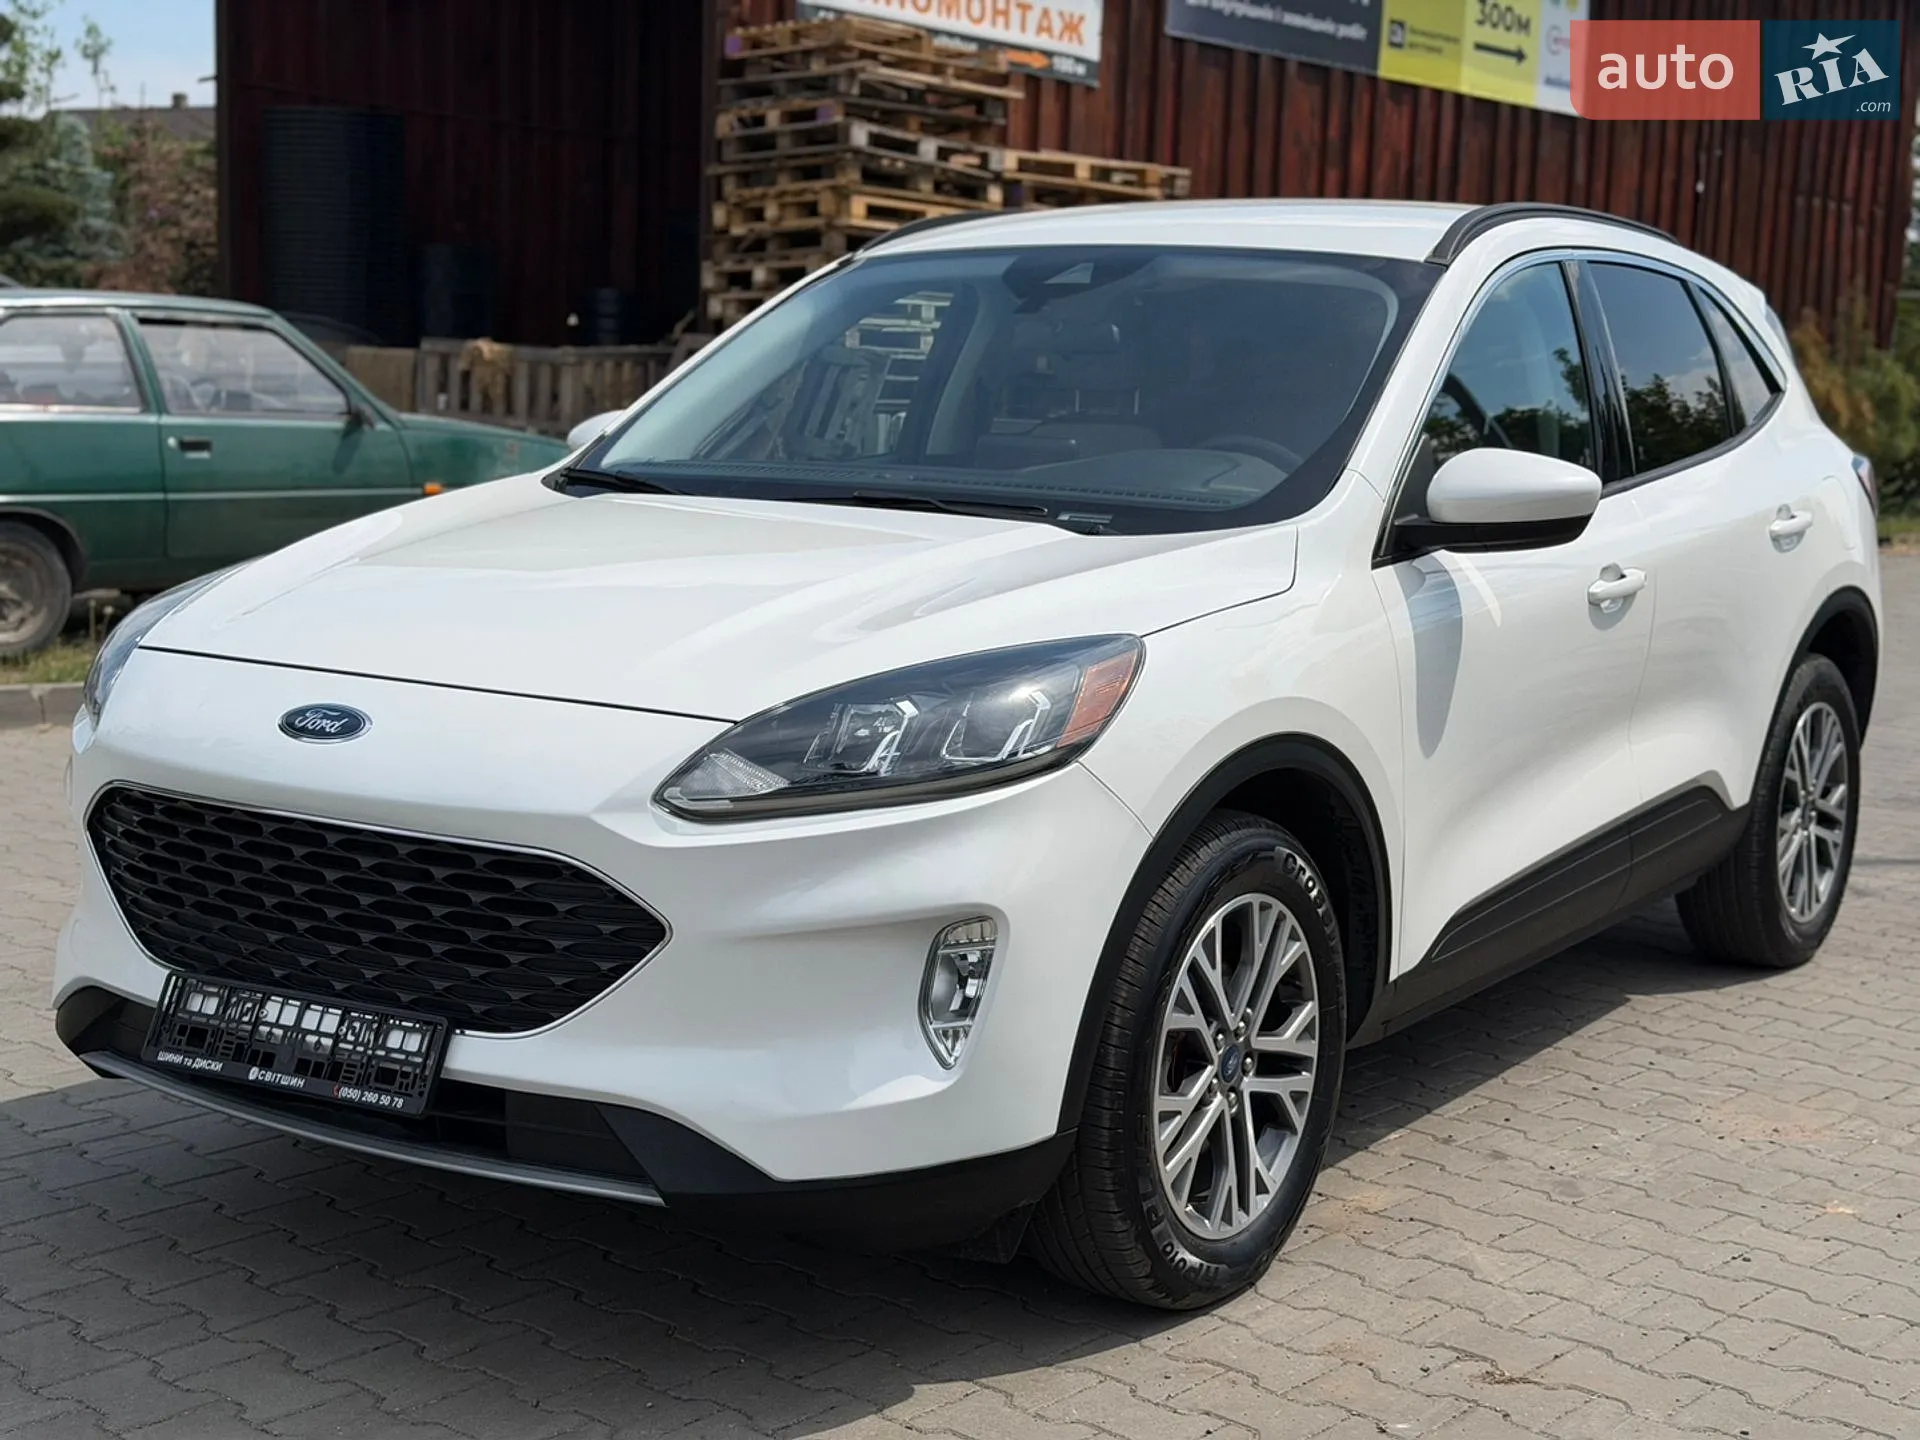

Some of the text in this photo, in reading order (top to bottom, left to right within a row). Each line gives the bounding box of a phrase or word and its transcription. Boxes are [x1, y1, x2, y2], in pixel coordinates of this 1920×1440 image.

[859, 0, 1086, 46] МОНТАЖ
[294, 708, 349, 733] Ford
[157, 1051, 183, 1063] ШИНИ
[192, 1058, 224, 1072] ДИСКИ
[258, 1072, 306, 1089] СВІТШИН
[338, 1086, 404, 1109] (050) 260 50 78
